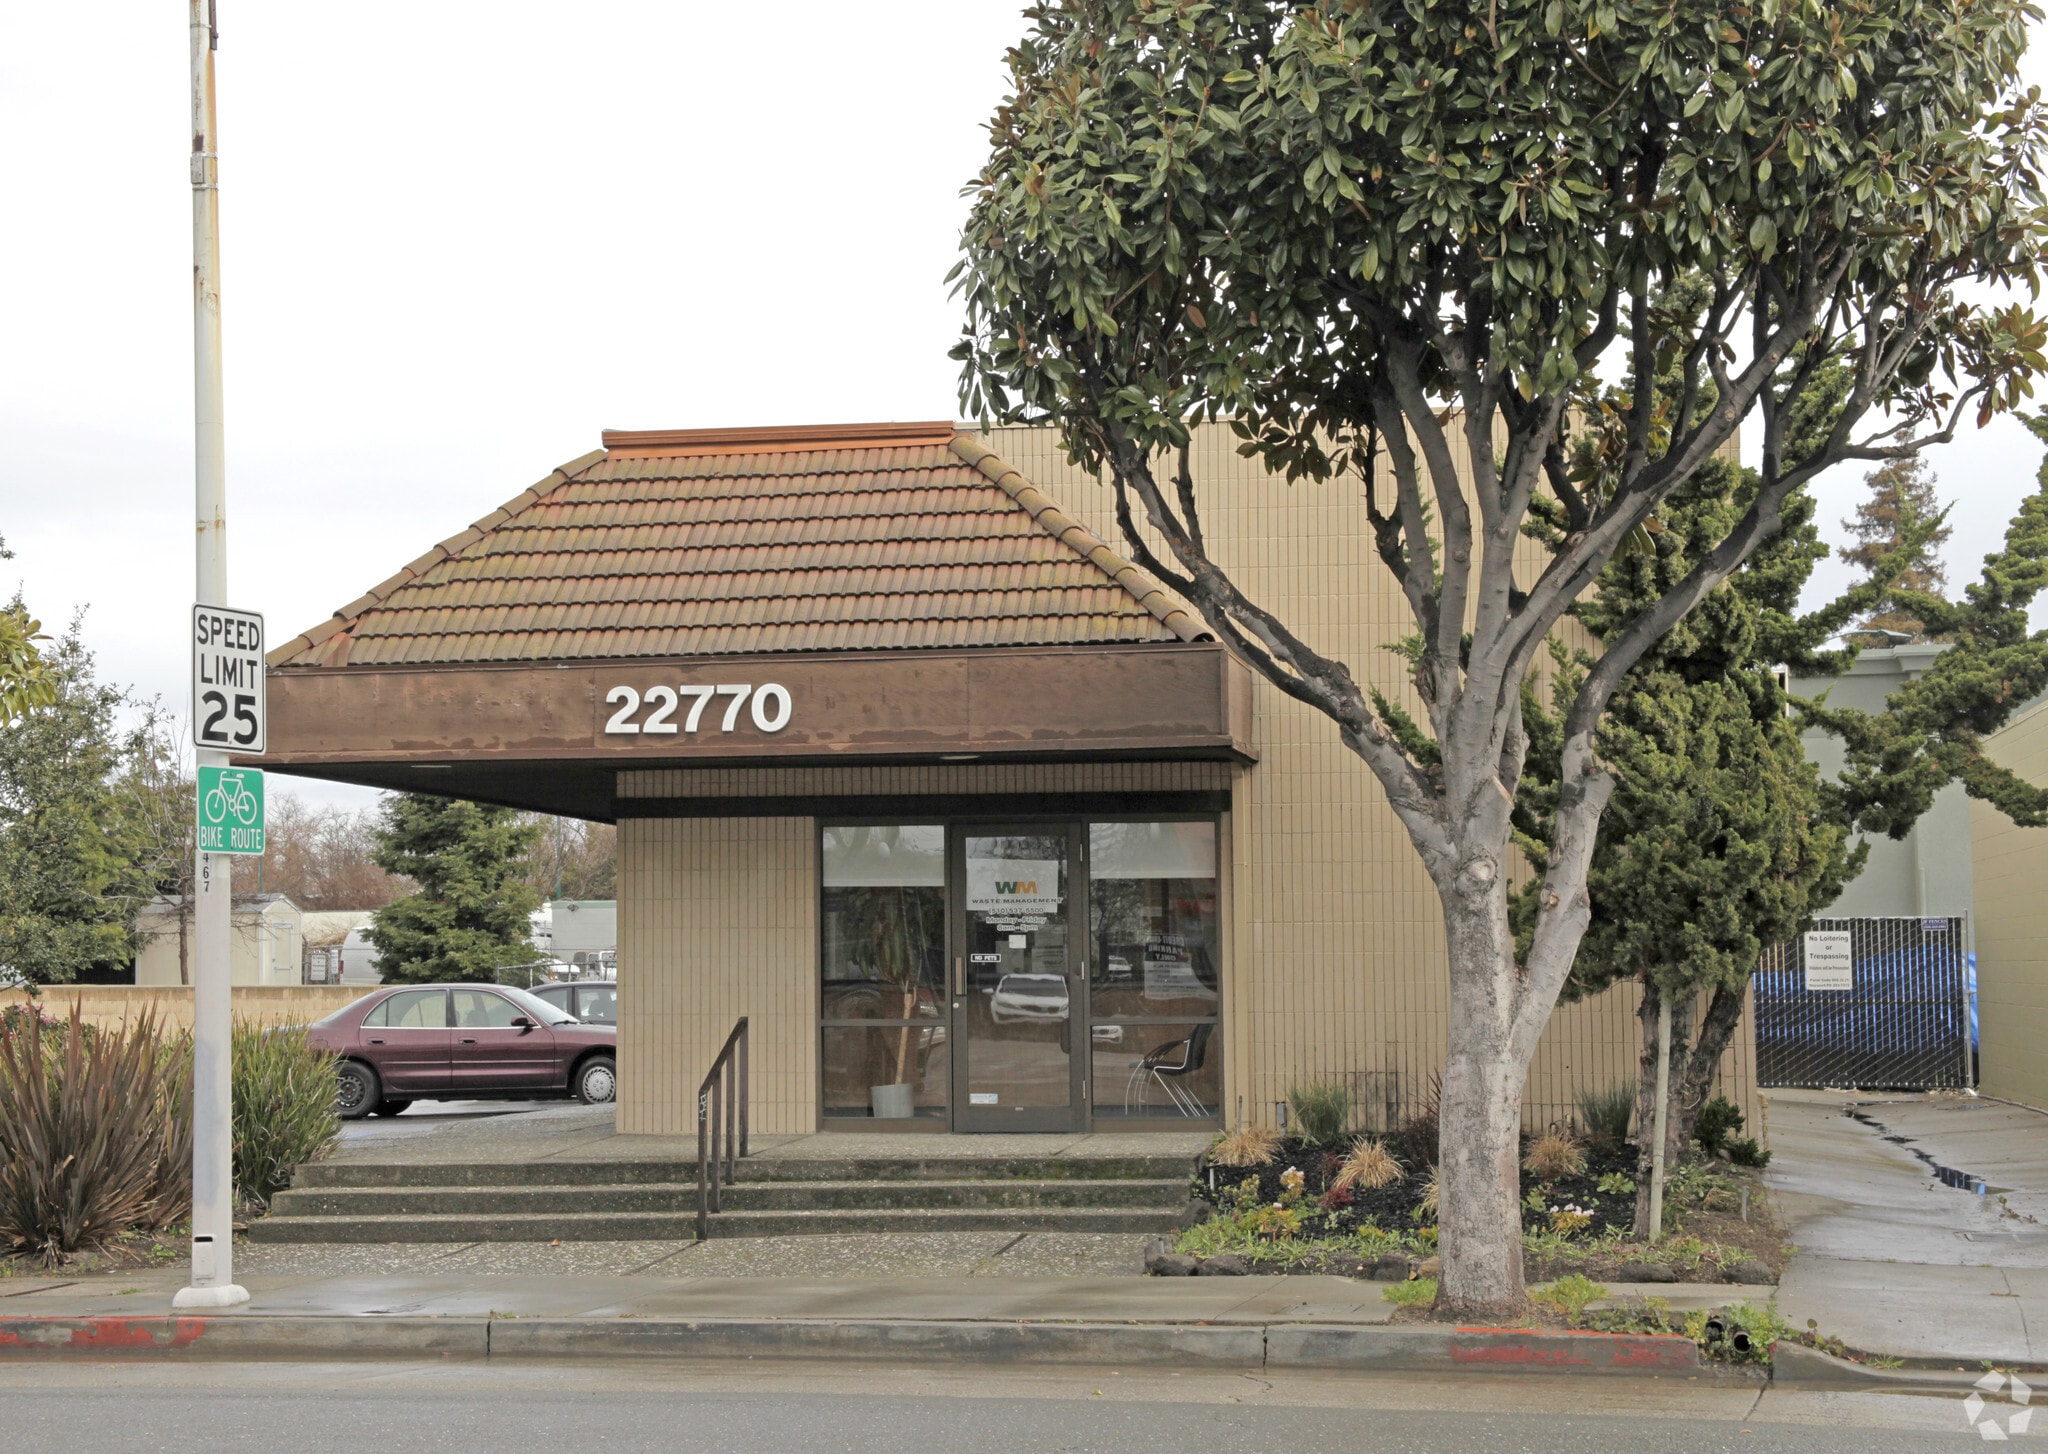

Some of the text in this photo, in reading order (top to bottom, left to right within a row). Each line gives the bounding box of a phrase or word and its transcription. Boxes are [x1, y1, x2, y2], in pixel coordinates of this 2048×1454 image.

[197, 614, 260, 651] SPEED
[200, 653, 258, 689] LIMIT
[201, 690, 258, 745] 25
[605, 682, 792, 734] 22770
[200, 825, 262, 850] BIKE ROUTE
[995, 881, 1038, 894] WM
[1022, 916, 1047, 924] Friday
[1819, 935, 1849, 943] Loitering
